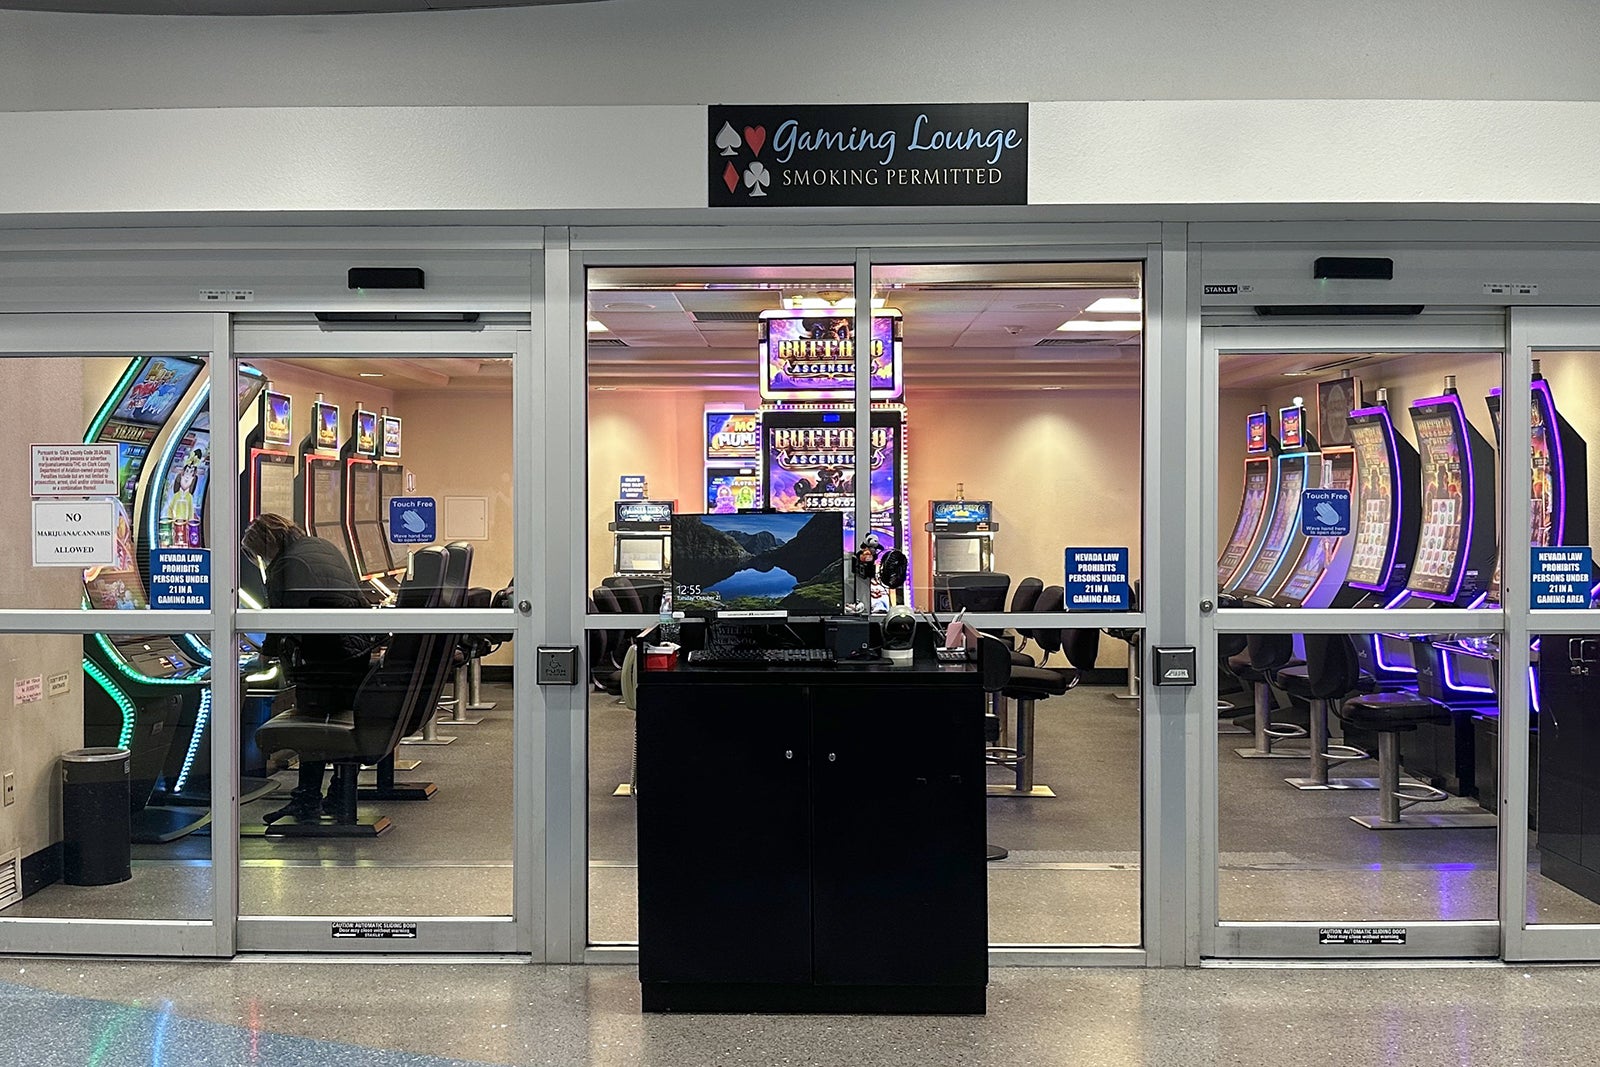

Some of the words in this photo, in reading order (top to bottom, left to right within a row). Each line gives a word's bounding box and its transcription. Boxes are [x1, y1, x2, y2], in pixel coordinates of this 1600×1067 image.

[773, 119, 897, 165] Gaming
[908, 114, 1023, 165] Lounge
[782, 170, 878, 186] SMOKING
[887, 168, 1002, 185] PERMITTED
[778, 340, 883, 357] BUFFAO
[792, 364, 855, 372] ASCENSI
[775, 429, 886, 448] BUFFAO
[66, 513, 81, 522] NO
[1075, 553, 1102, 561] NEVADA
[1104, 553, 1119, 561] LAW
[1533, 574, 1565, 582] PERSONS
[1566, 574, 1588, 582] UNDER
[676, 585, 701, 594] 12:55
[1537, 595, 1565, 603] GAMING
[1566, 595, 1584, 603] AREA
